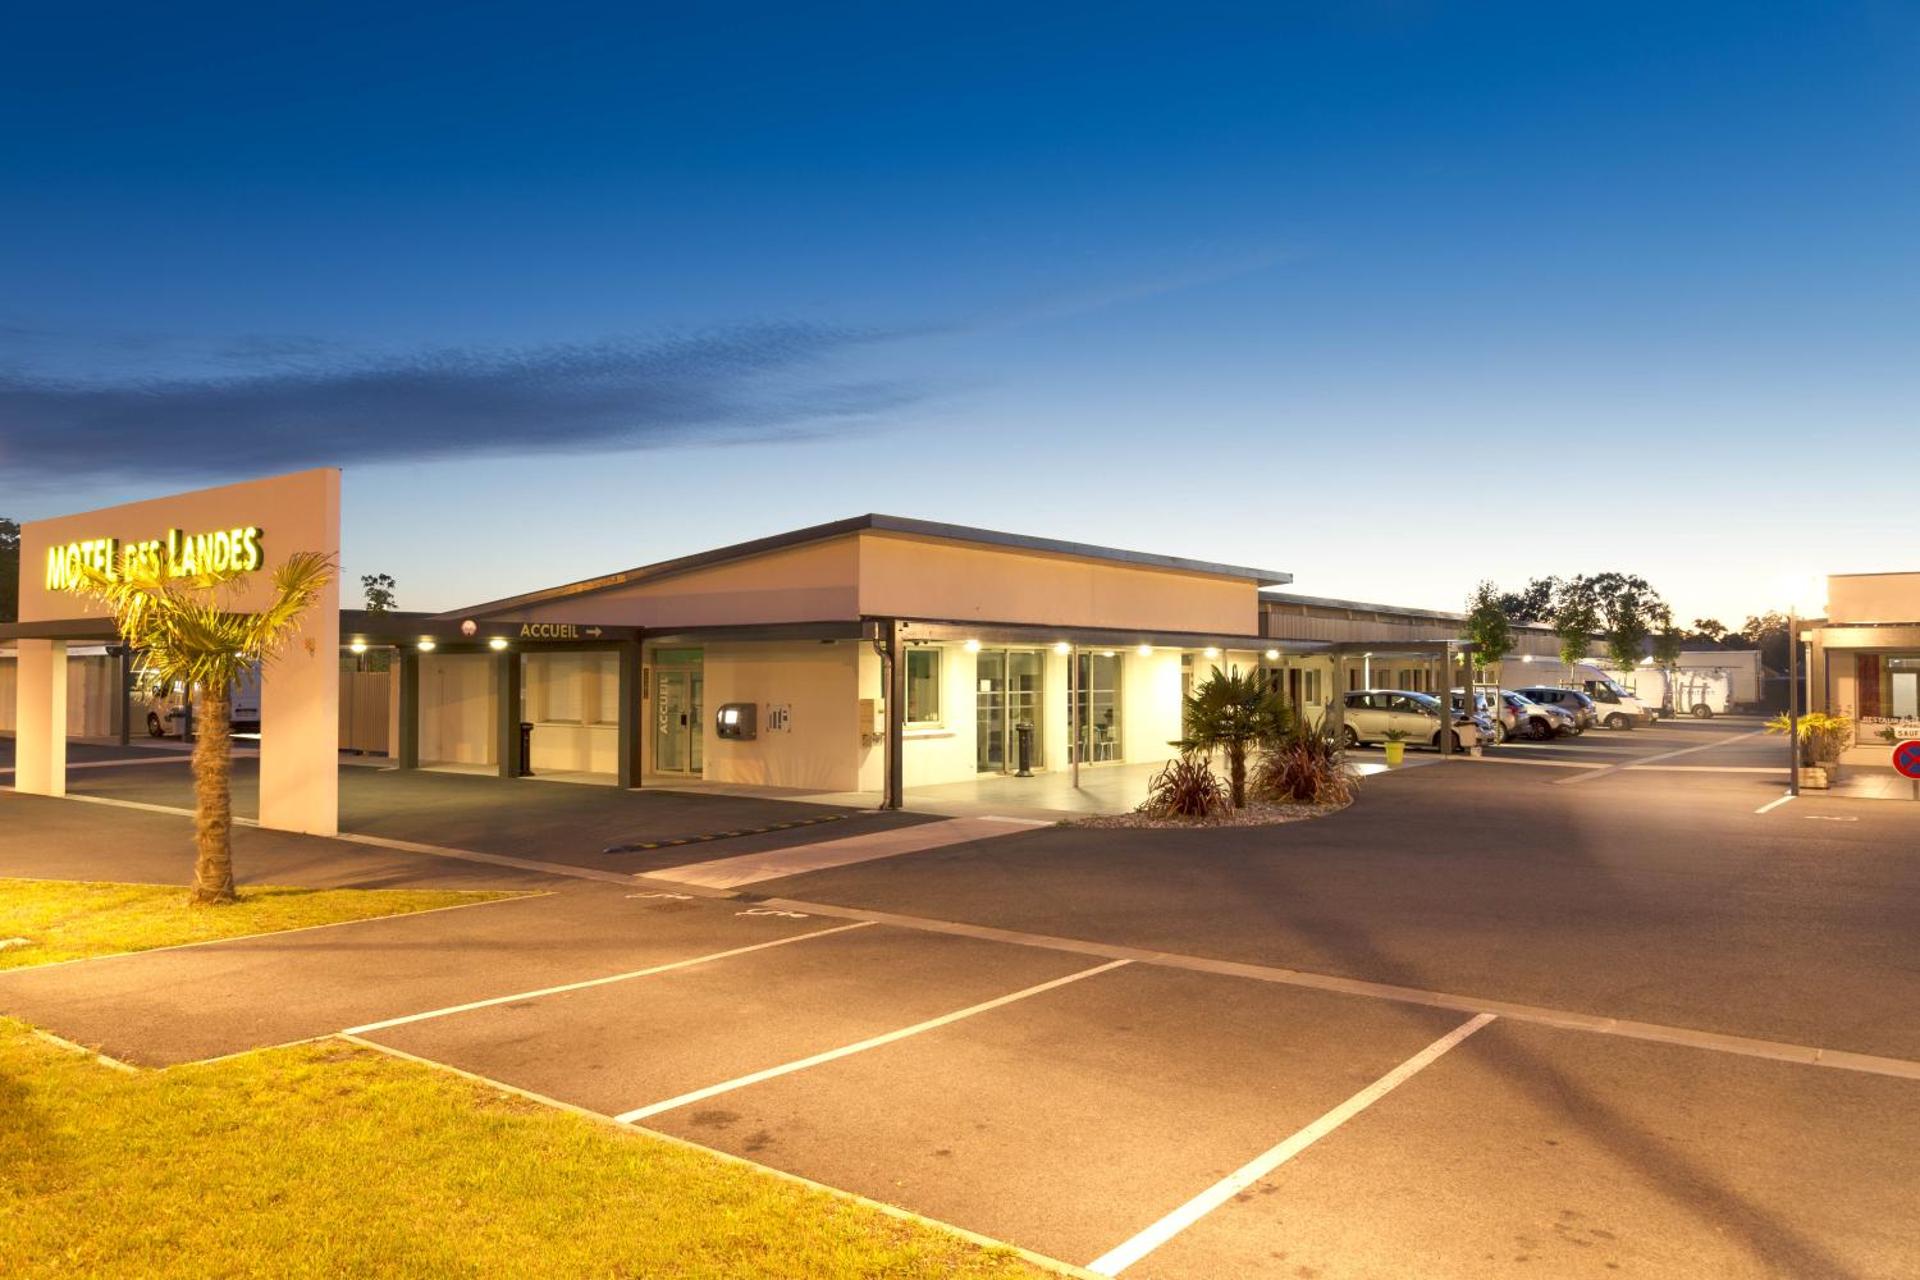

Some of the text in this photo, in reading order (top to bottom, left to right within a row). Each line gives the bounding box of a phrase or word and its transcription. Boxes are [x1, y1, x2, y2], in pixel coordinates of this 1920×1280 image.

[46, 538, 118, 590] MOTEL
[520, 624, 579, 639] ACCUEIL
[659, 676, 669, 735] ACCUEIL
